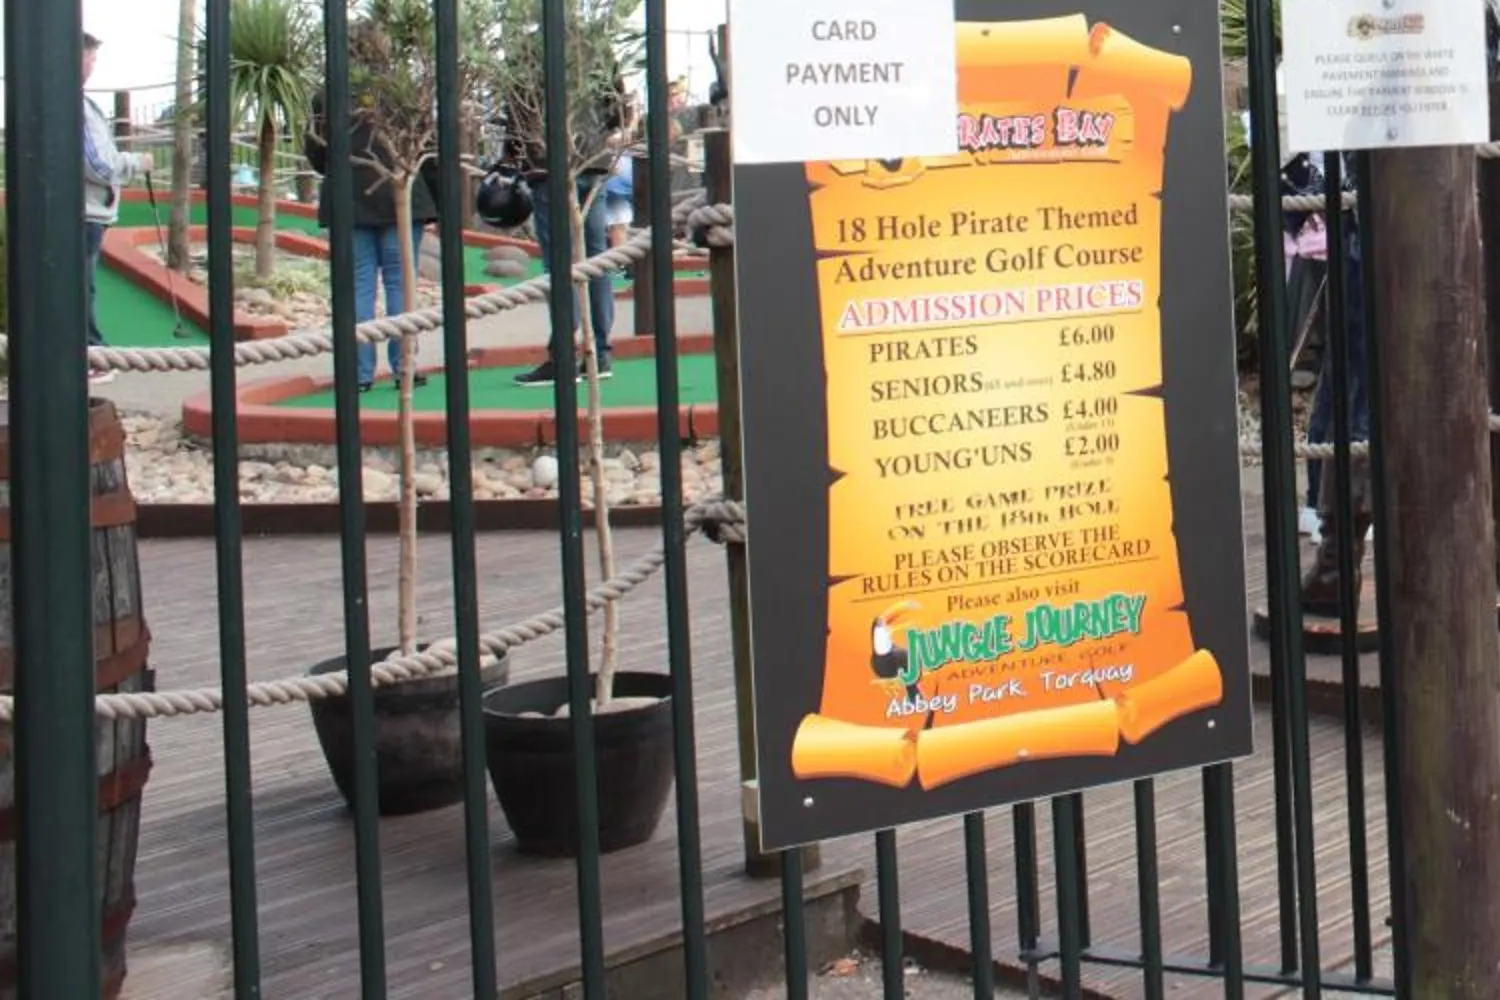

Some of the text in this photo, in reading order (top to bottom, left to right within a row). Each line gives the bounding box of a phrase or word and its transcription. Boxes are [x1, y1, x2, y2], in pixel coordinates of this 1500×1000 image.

[811, 20, 877, 41] CARD
[786, 61, 904, 85] PAYMENT
[813, 105, 878, 128] ONLY
[958, 105, 1114, 152] RATES BAY
[837, 203, 1138, 244] 18 Hole Pirate Themed
[834, 243, 1143, 284] Adventure Golf Course
[841, 282, 1142, 328] ADMISSION PRICES
[869, 324, 1115, 363] PIRATES £6.00
[871, 372, 983, 402] SENIORS
[1061, 360, 1116, 383] £4.80
[873, 397, 1117, 440] BUCCANEERS £4.00
[875, 433, 1119, 478] YOUNG'UNS £2.00
[895, 479, 1113, 520] FREE GAME PRIZE
[888, 500, 1121, 541] ON THE 18th HOLE
[862, 539, 1152, 594] RULES ON THE SCORECARD
[893, 523, 1121, 570] PLEASE OBSERVE THE
[947, 579, 1081, 614] Please also visit
[898, 593, 1148, 685] JUNGLE JOURNEY
[886, 692, 957, 718] Abbey
[1040, 664, 1134, 692] Torquay
